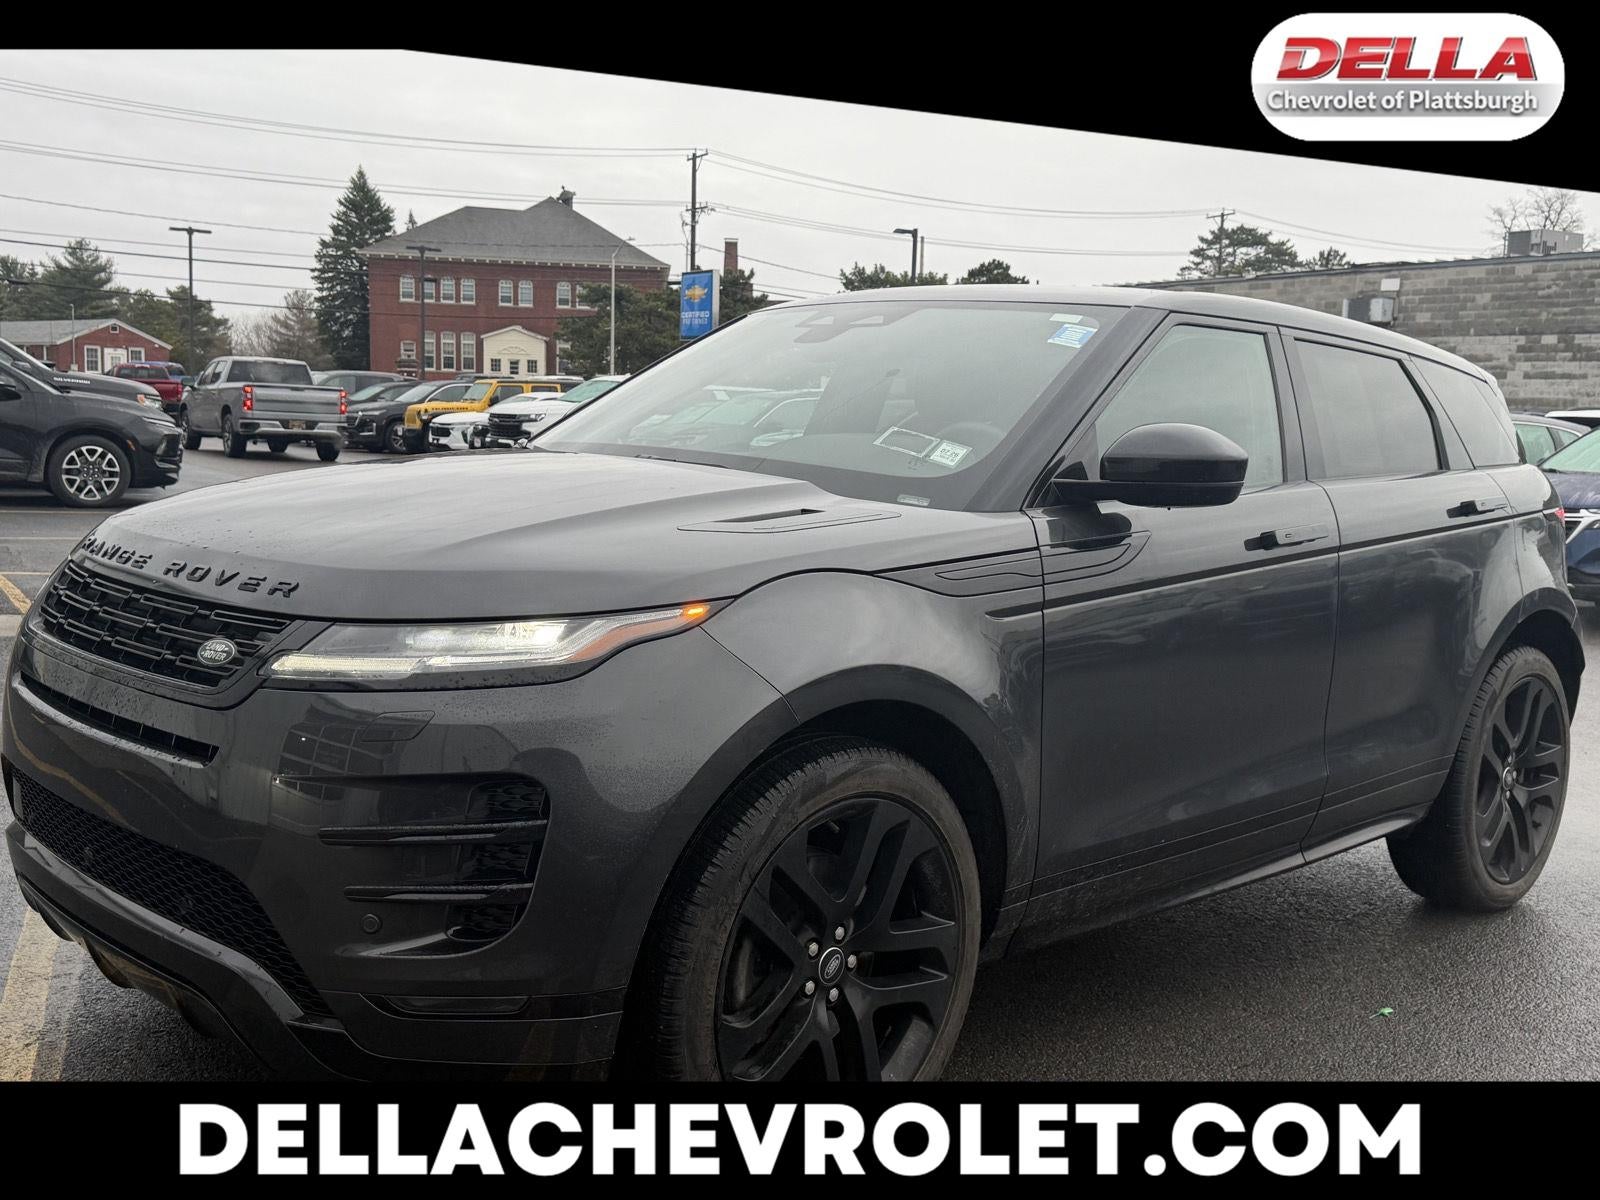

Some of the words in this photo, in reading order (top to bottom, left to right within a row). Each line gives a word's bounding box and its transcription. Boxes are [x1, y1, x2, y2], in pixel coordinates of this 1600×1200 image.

[81, 536, 153, 570] RANGE
[163, 560, 300, 599] ROVER
[205, 642, 226, 652] LAND
[202, 650, 228, 661] ROVER
